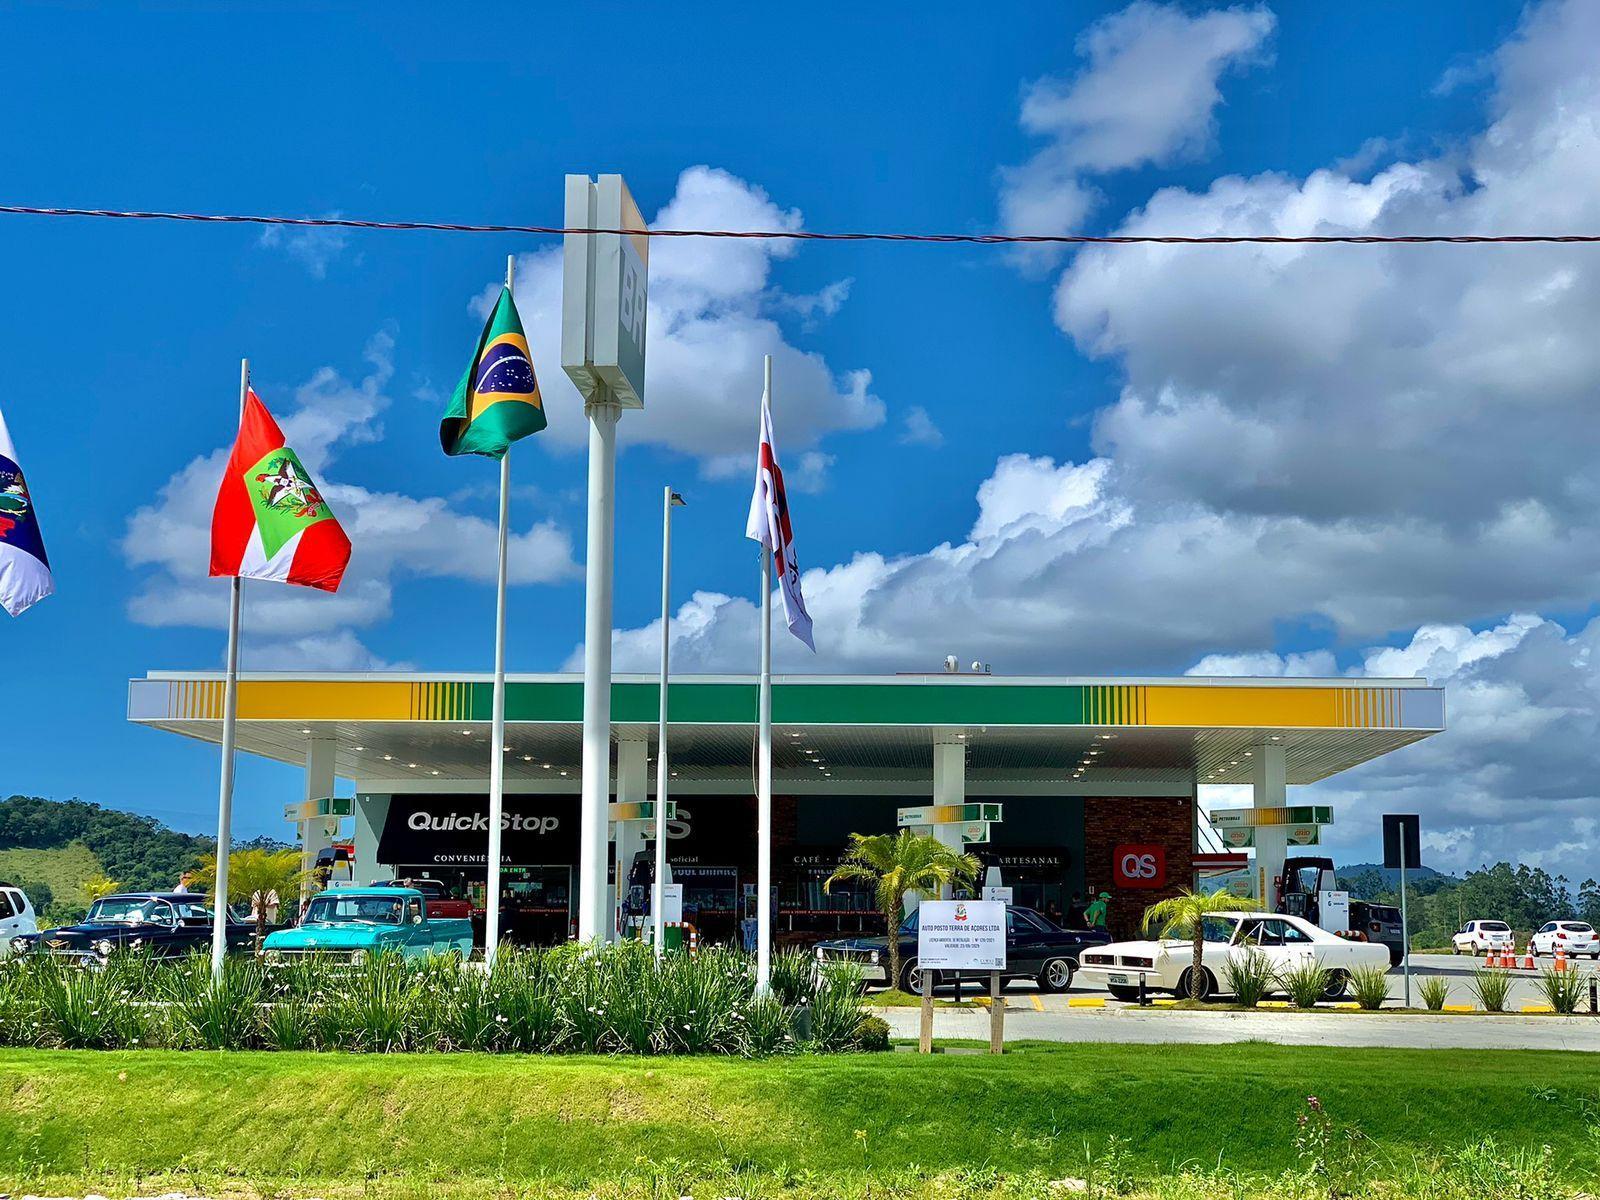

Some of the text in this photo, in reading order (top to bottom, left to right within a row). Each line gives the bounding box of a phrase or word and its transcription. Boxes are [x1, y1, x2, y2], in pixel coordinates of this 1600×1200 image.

[621, 247, 647, 357] BR
[407, 811, 489, 830] Quick
[433, 854, 512, 862] CONVENIÊIA
[793, 855, 821, 863] CAFÉ
[1121, 853, 1157, 879] QS
[971, 925, 989, 933] AÇORES
